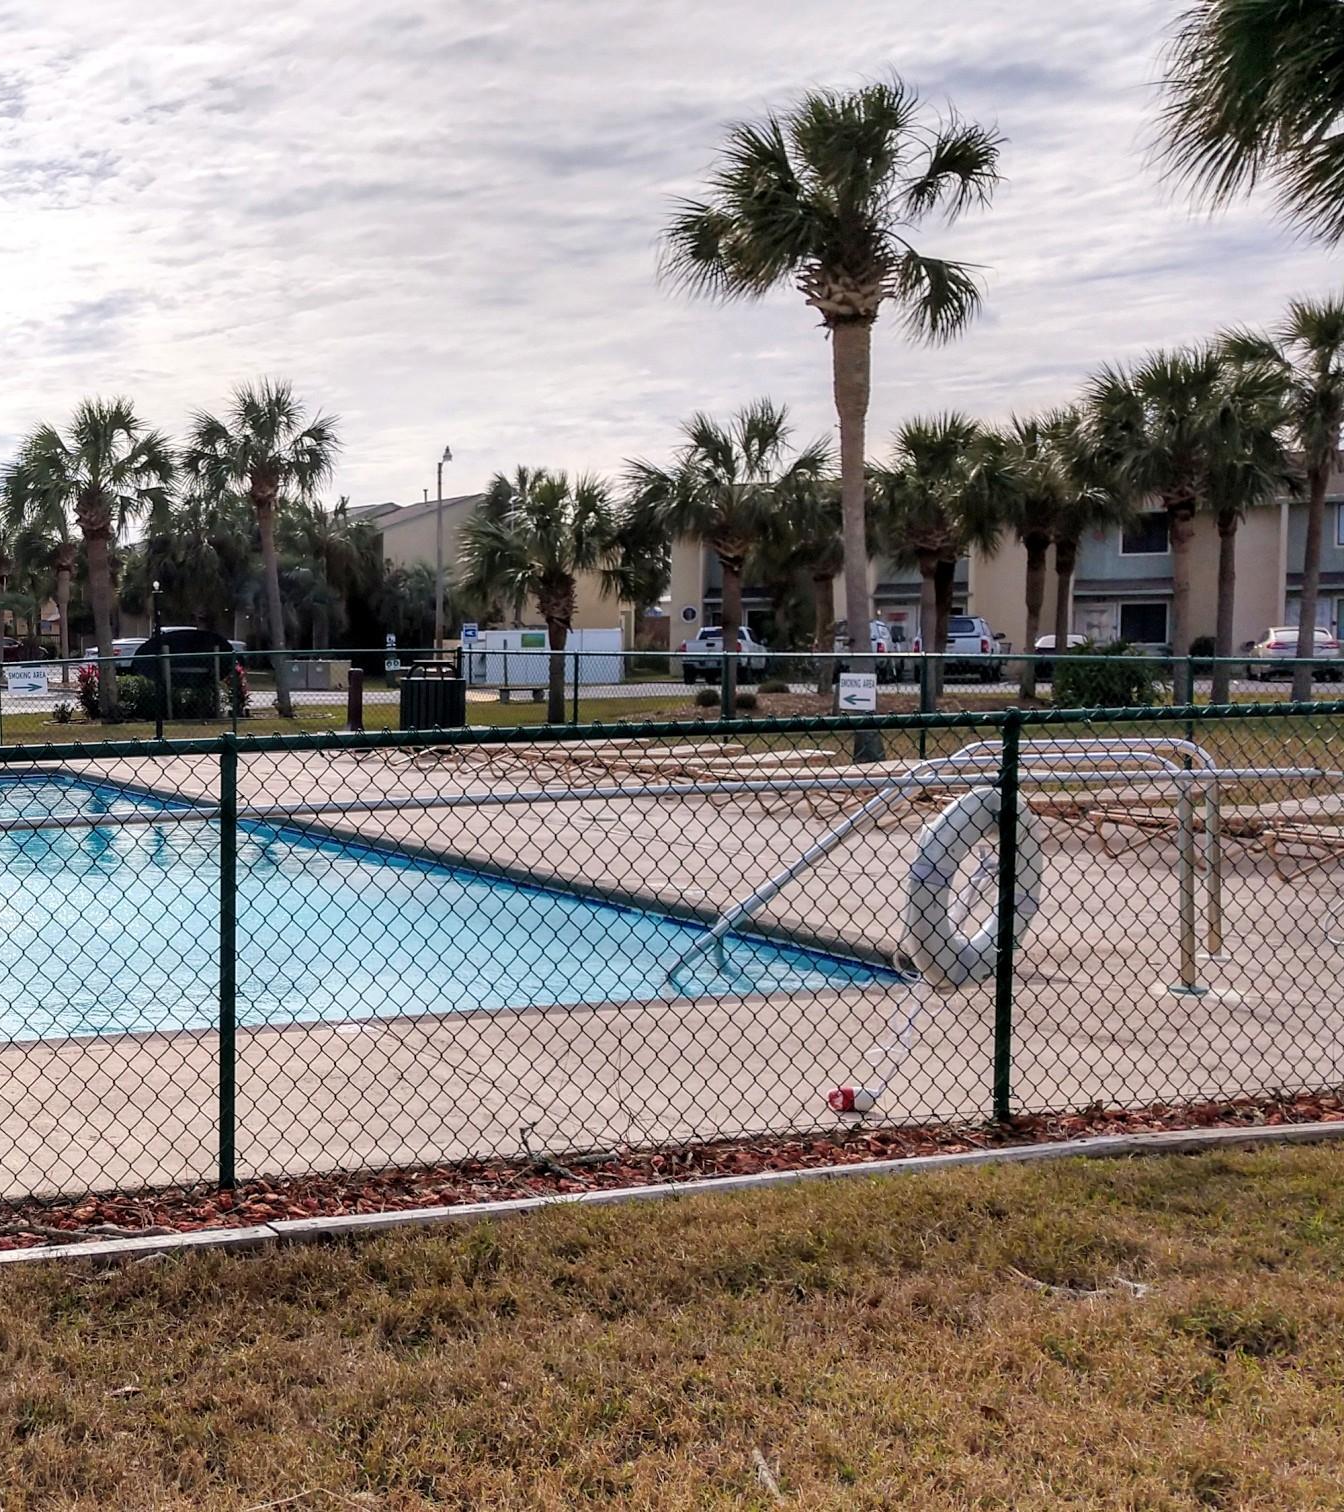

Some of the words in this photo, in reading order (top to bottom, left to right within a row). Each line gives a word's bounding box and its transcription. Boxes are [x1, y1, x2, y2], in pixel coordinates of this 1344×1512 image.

[8, 671, 31, 679] SMOKING
[840, 679, 861, 688] SMOKING
[863, 679, 875, 688] AREA
